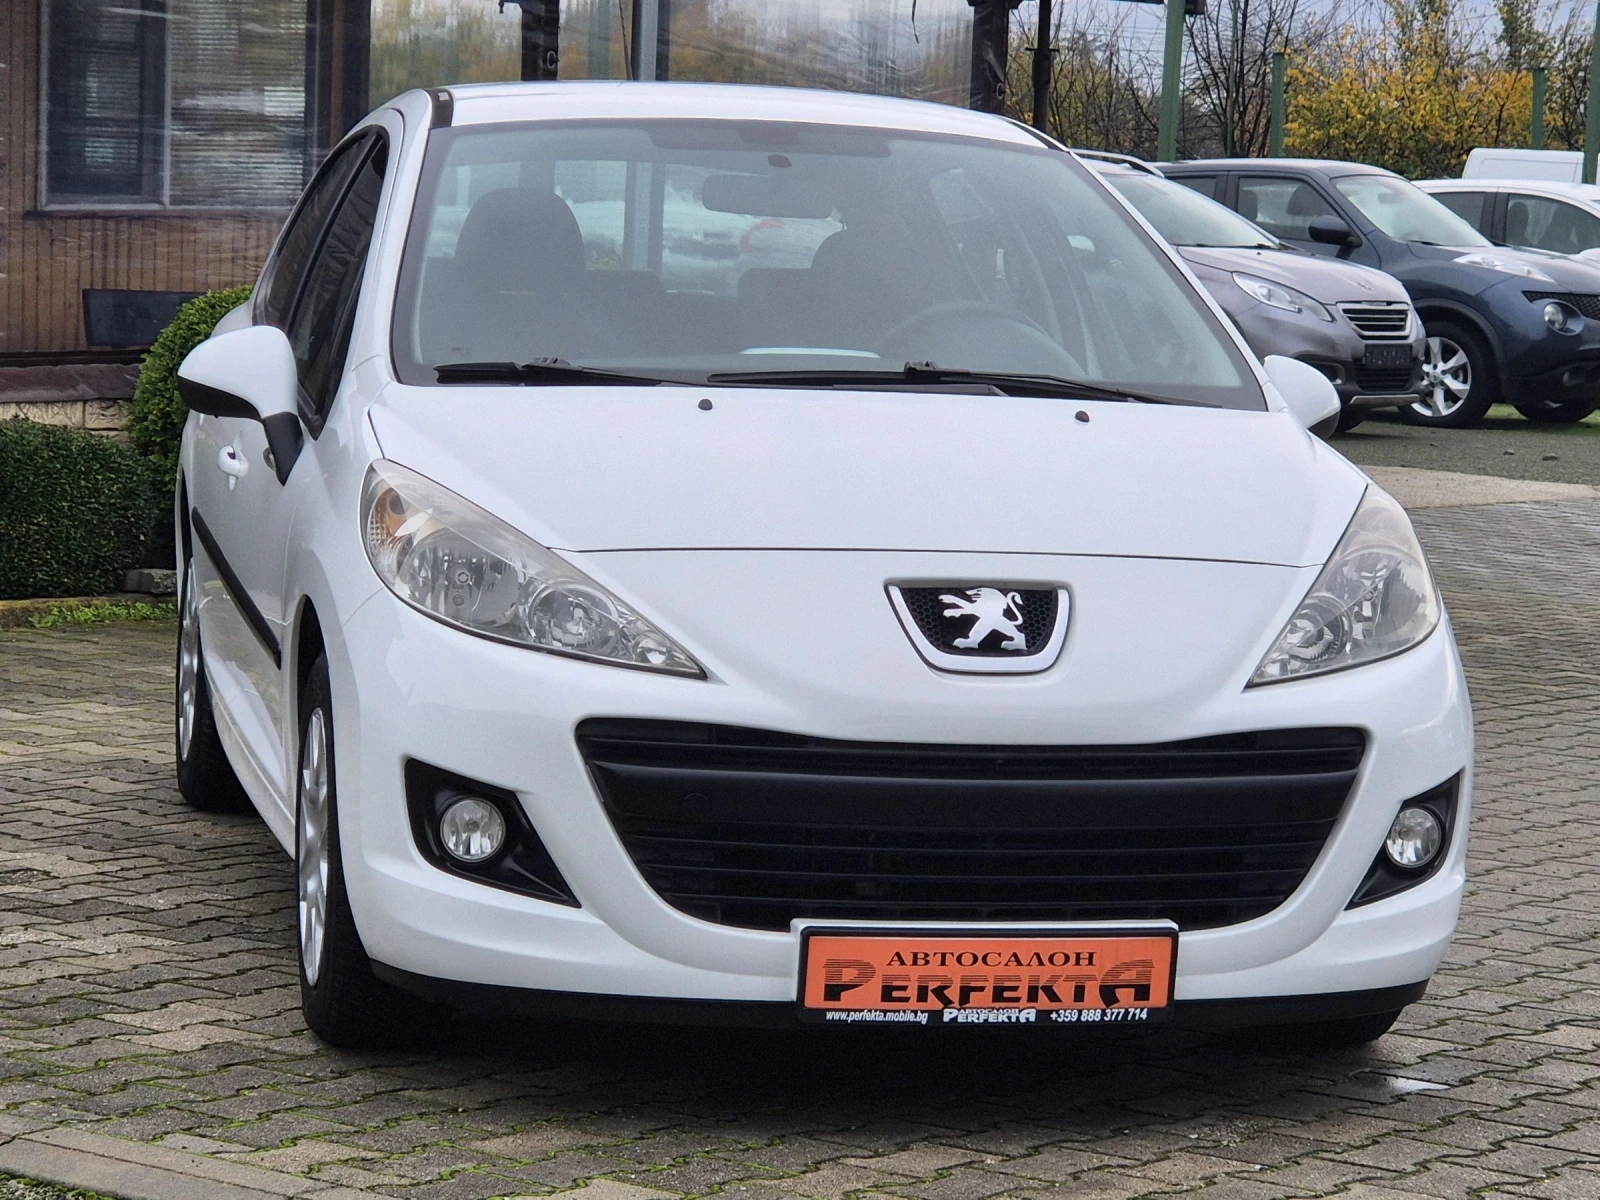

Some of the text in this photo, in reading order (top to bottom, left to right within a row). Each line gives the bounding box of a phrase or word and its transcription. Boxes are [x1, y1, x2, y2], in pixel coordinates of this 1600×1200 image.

[886, 951, 1097, 967] АВТОСАЛОН
[823, 958, 1154, 1007] PERFEKTA
[826, 1009, 929, 1025] www.perfekta.mobile.bg
[943, 1008, 1037, 1023] PERFEKTA
[1050, 1007, 1148, 1022] +359 888 377 714
